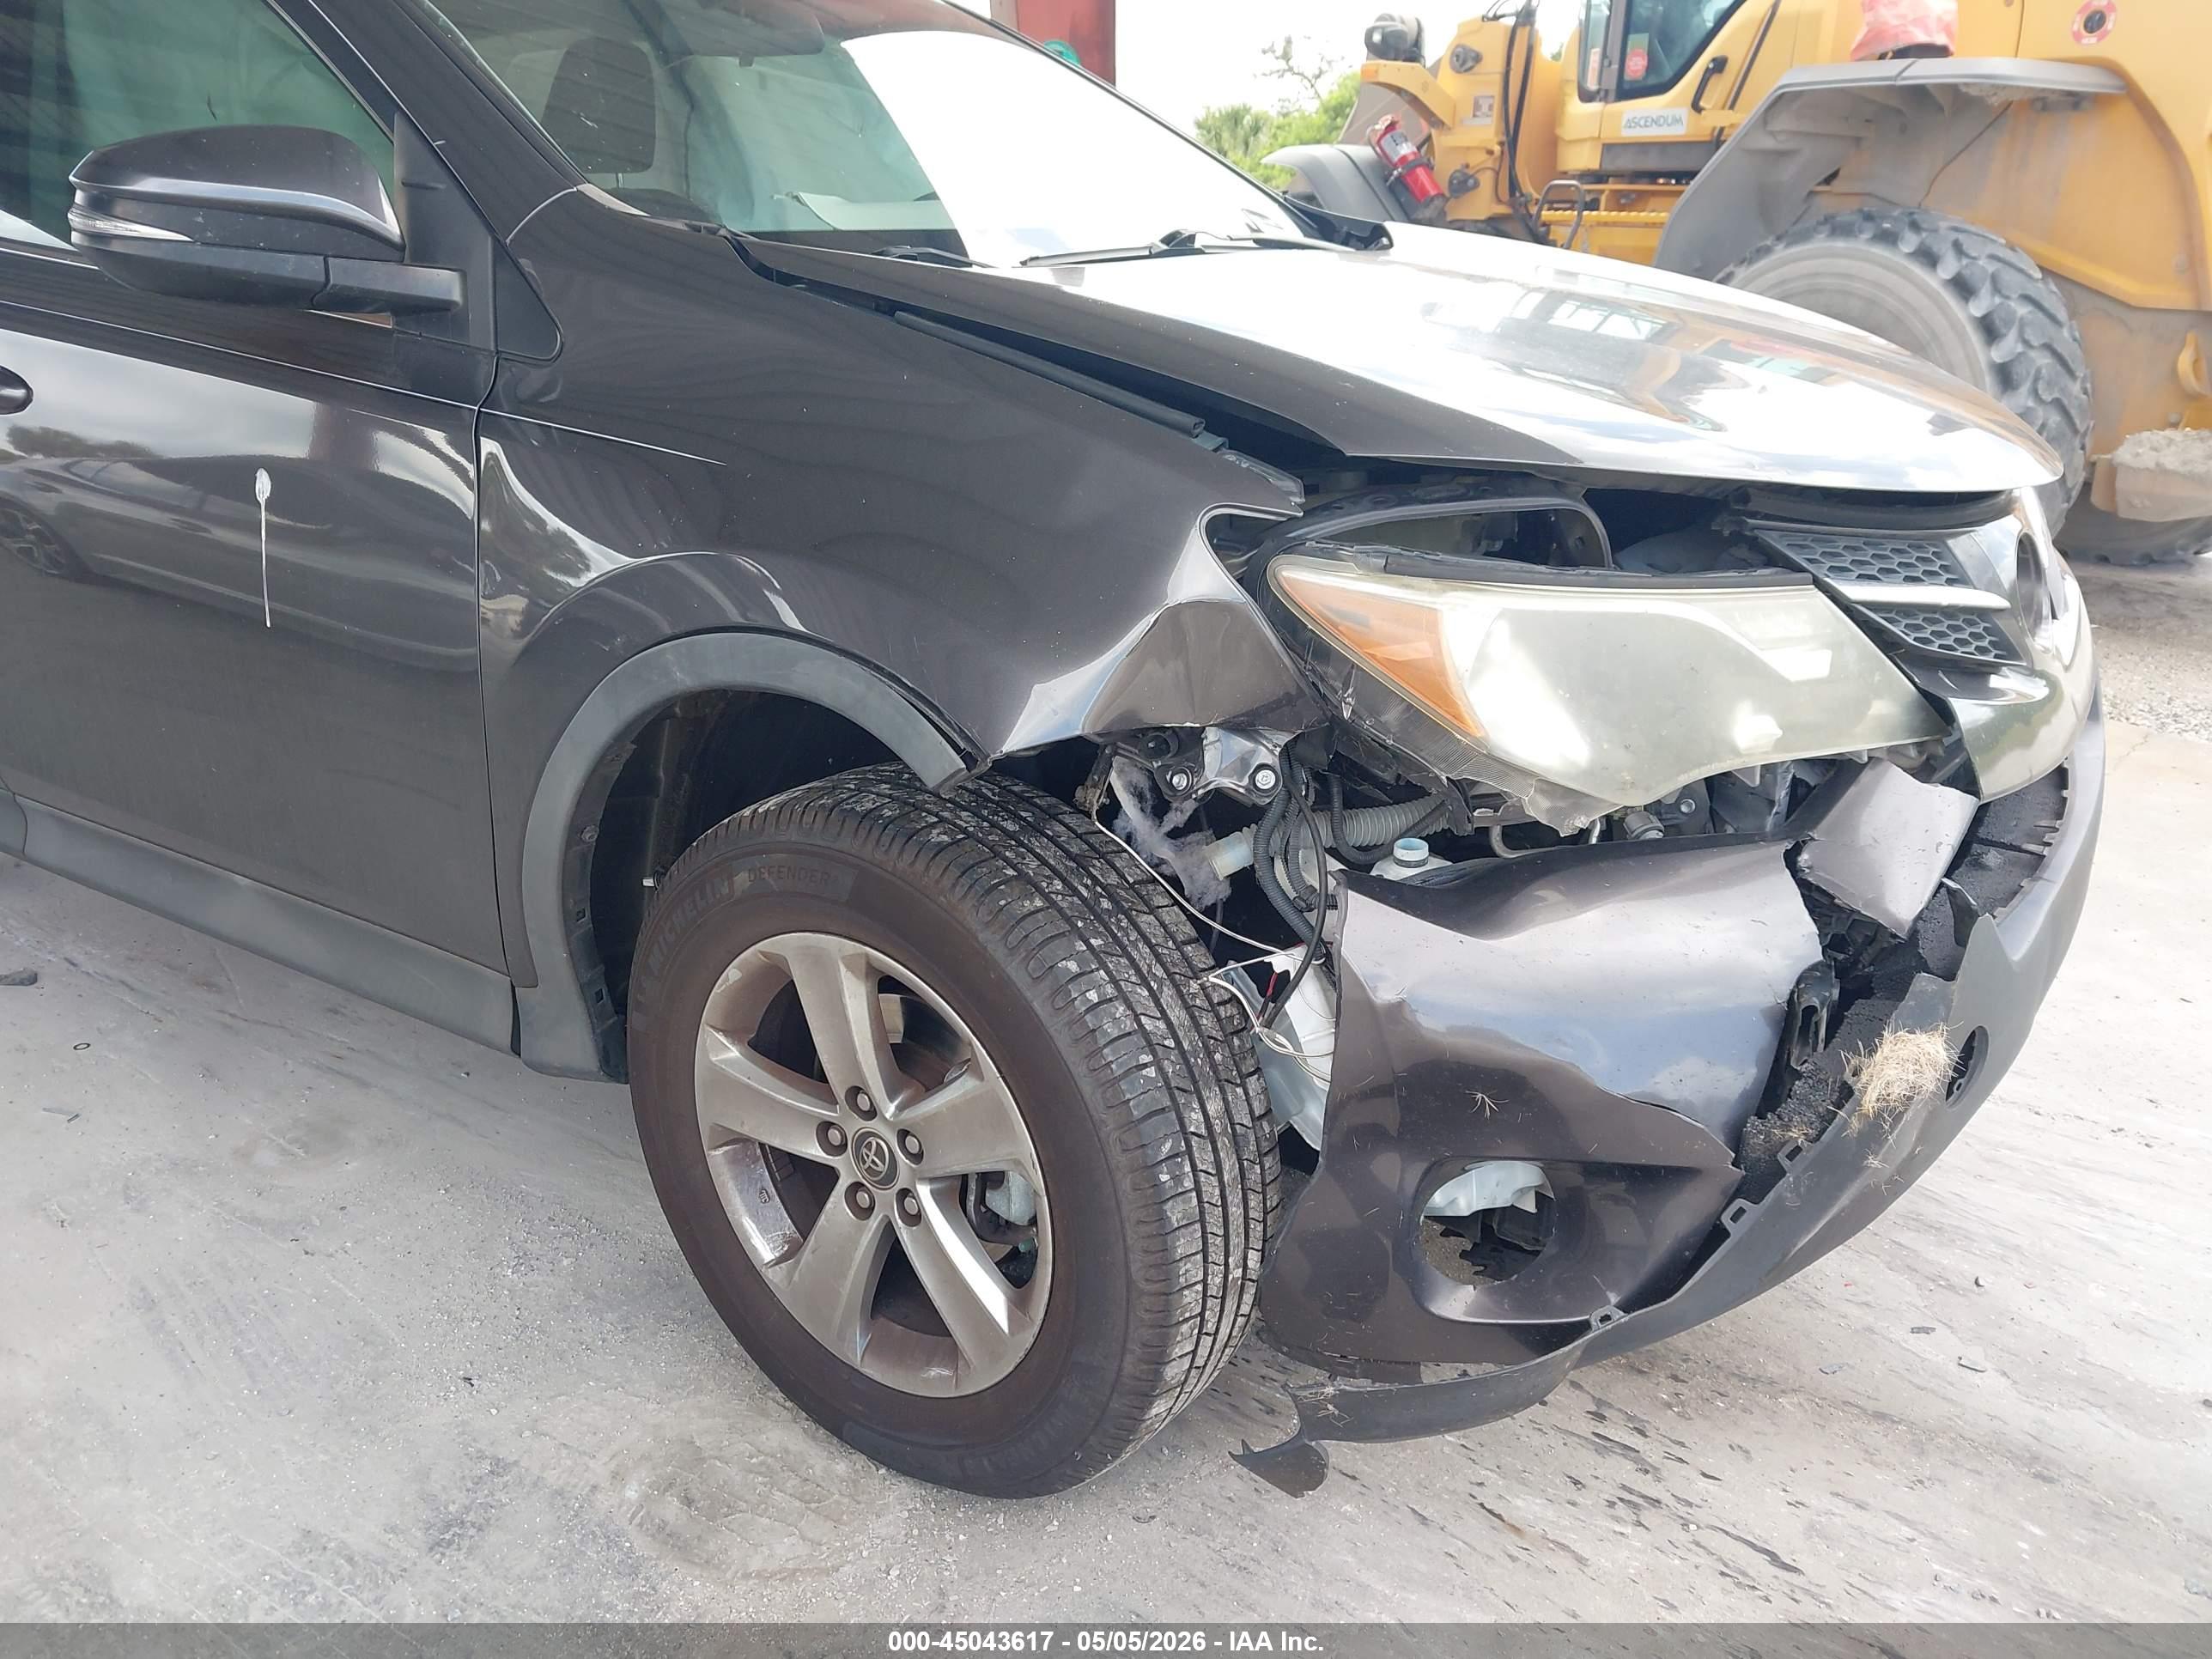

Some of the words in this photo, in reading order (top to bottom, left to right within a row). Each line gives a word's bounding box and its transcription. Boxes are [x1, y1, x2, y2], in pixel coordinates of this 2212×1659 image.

[1623, 114, 1684, 129] ASCENDUM
[648, 876, 731, 976] MICHELIN
[748, 865, 831, 886] DEFENDER
